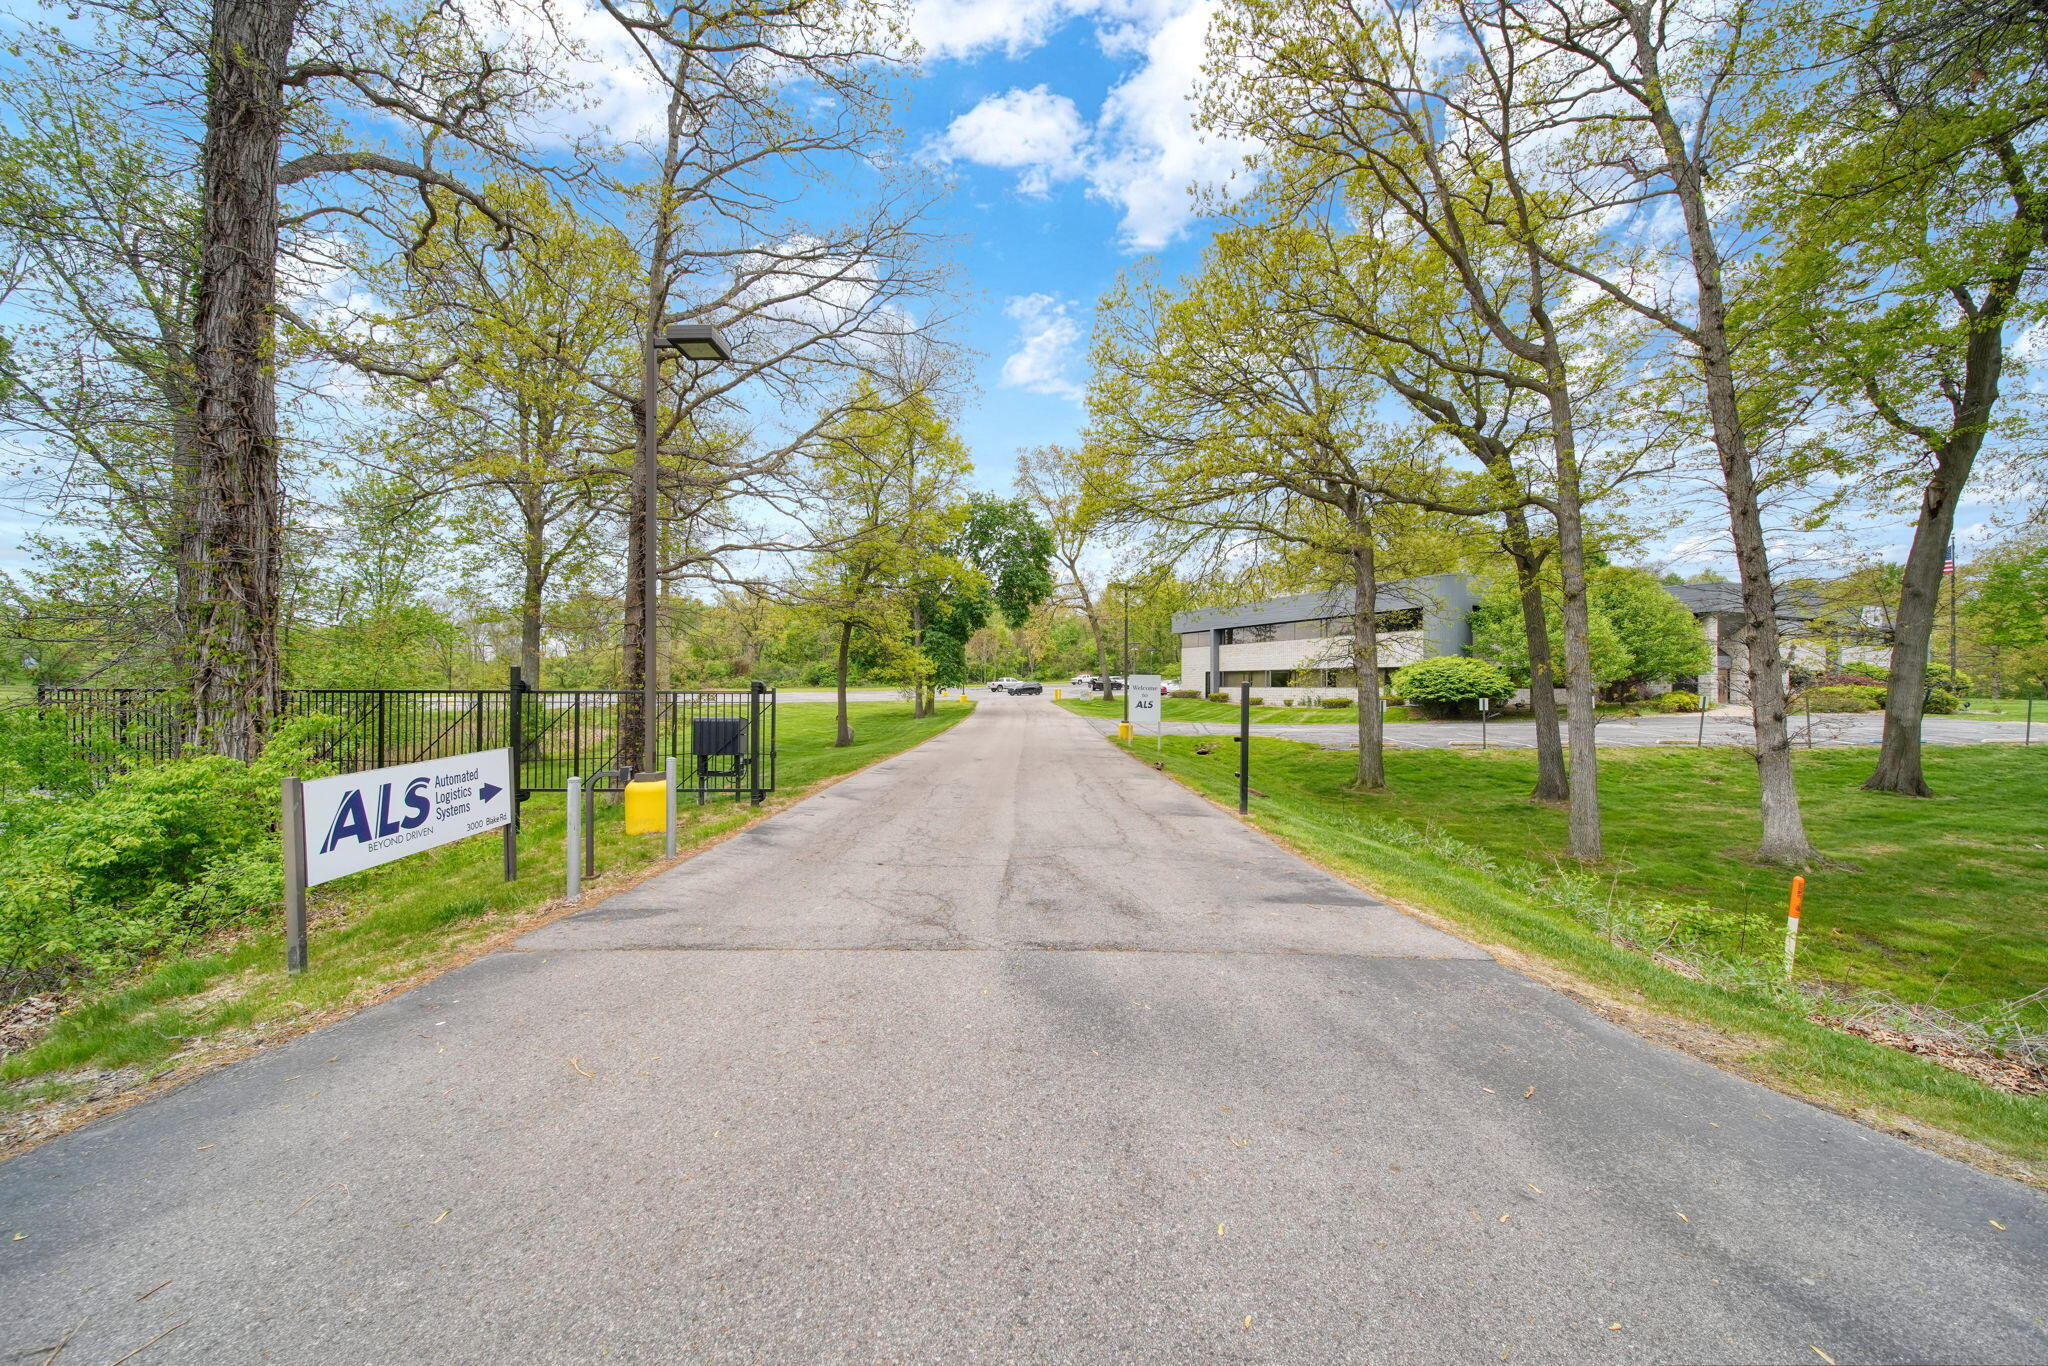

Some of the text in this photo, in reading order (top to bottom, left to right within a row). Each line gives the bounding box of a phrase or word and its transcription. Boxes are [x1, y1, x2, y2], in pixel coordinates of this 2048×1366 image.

[1135, 700, 1153, 709] ALS
[434, 768, 479, 788] Automated
[435, 786, 472, 804] Logistics
[319, 776, 431, 854] ALS
[436, 802, 471, 822] Systems
[466, 820, 484, 831] 3000
[486, 815, 500, 826] Blake
[368, 826, 434, 852] BEYOND DRIVEN
